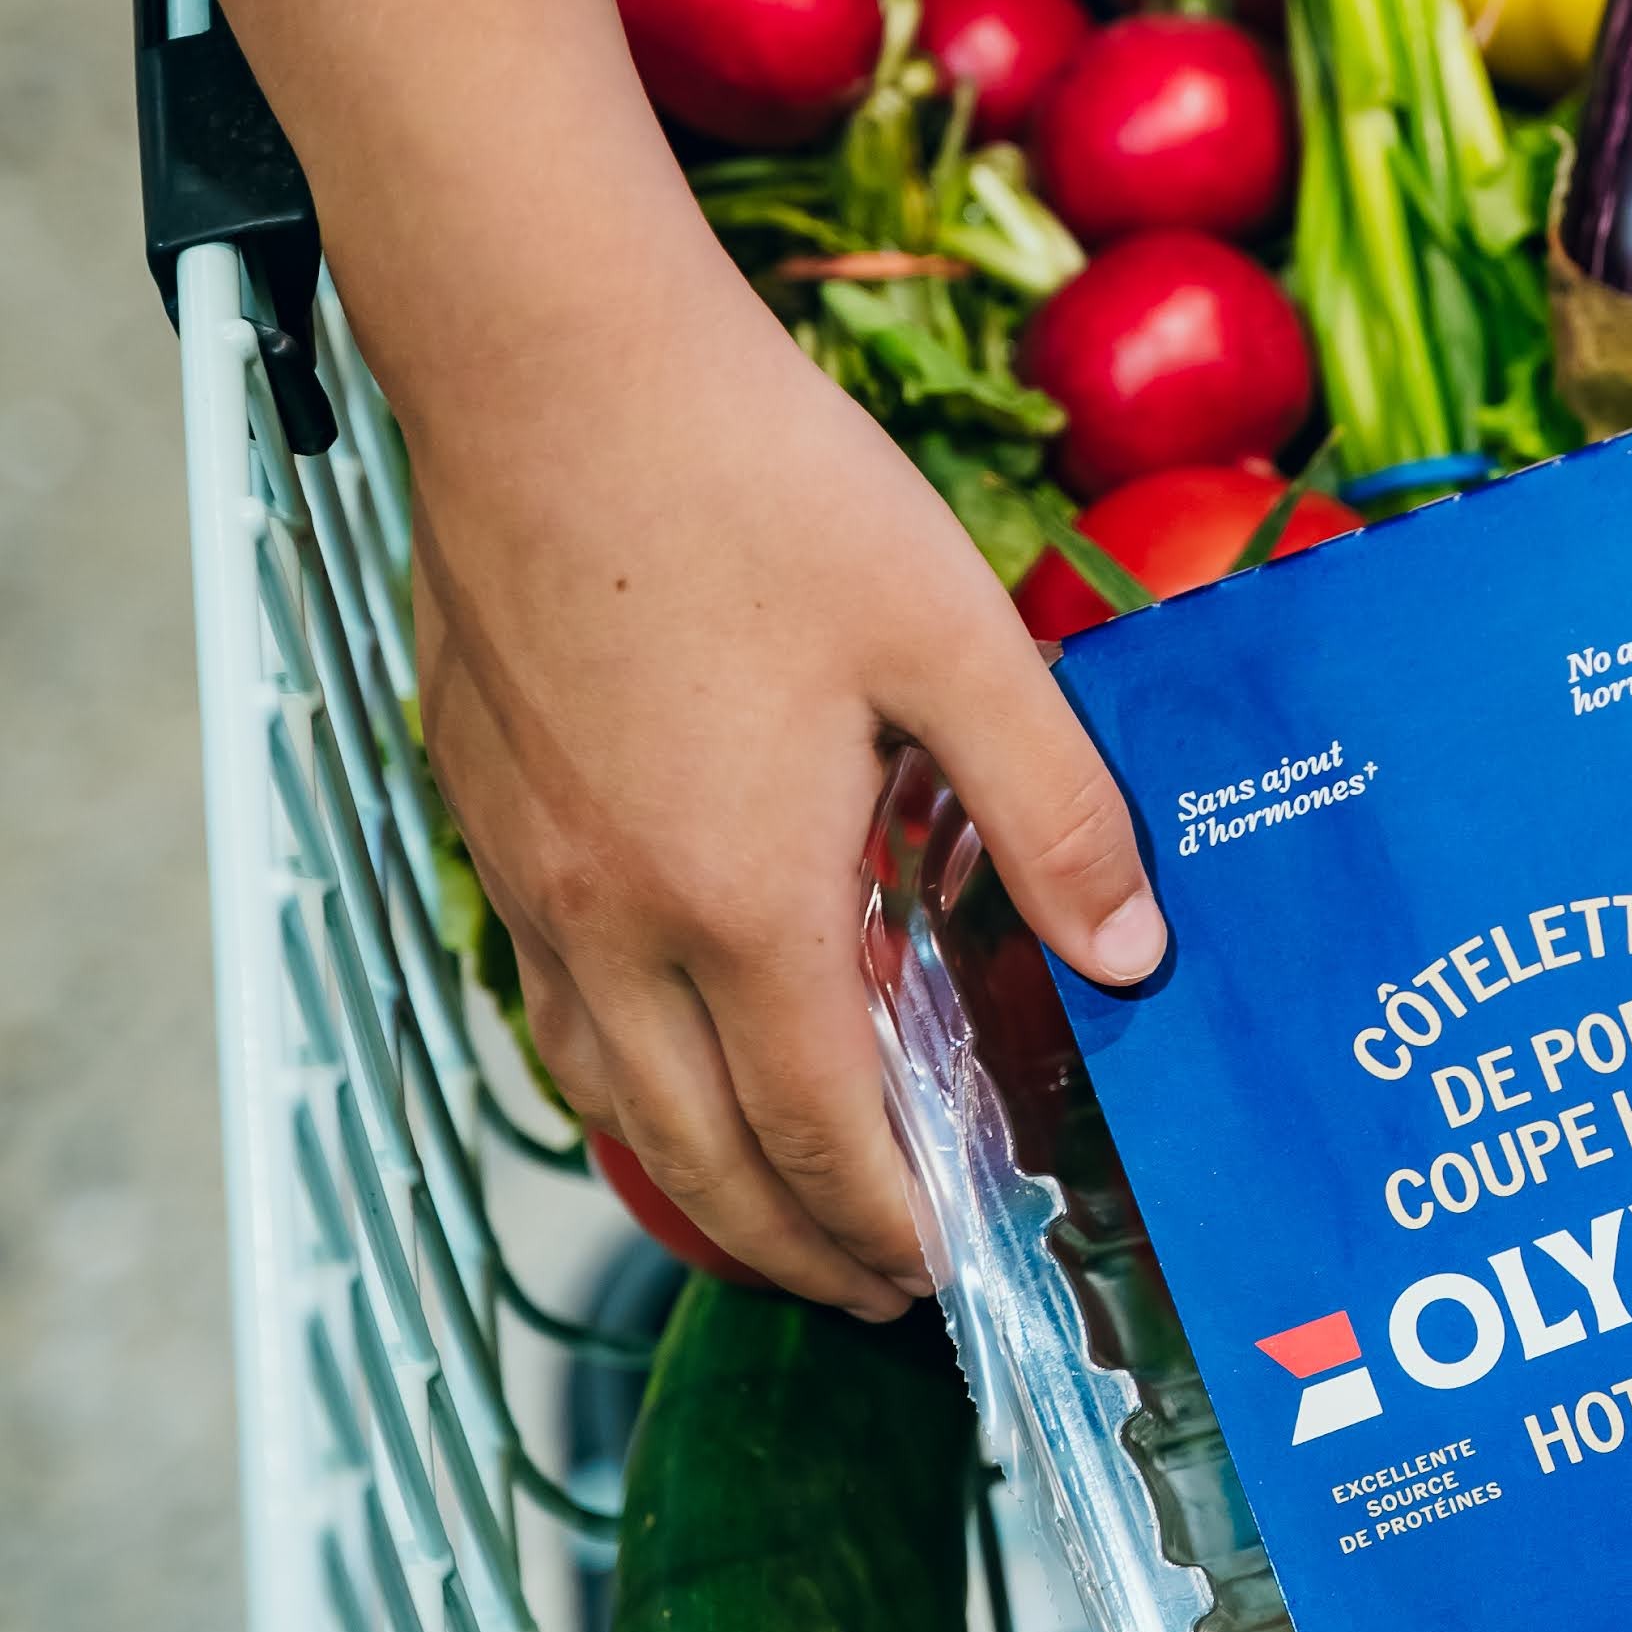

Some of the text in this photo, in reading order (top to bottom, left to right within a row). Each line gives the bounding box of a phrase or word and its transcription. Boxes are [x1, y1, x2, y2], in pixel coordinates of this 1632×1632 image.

[1567, 650, 1611, 685] No
[1178, 740, 1343, 822] Sans ajout
[1431, 1044, 1534, 1129] DE
[1384, 1101, 1614, 1231] COUPE
[1331, 1438, 1476, 1504] EXCELLENTE
[1366, 1471, 1459, 1517] SOURCE
[1339, 1482, 1502, 1554] DE PROTÉINES
